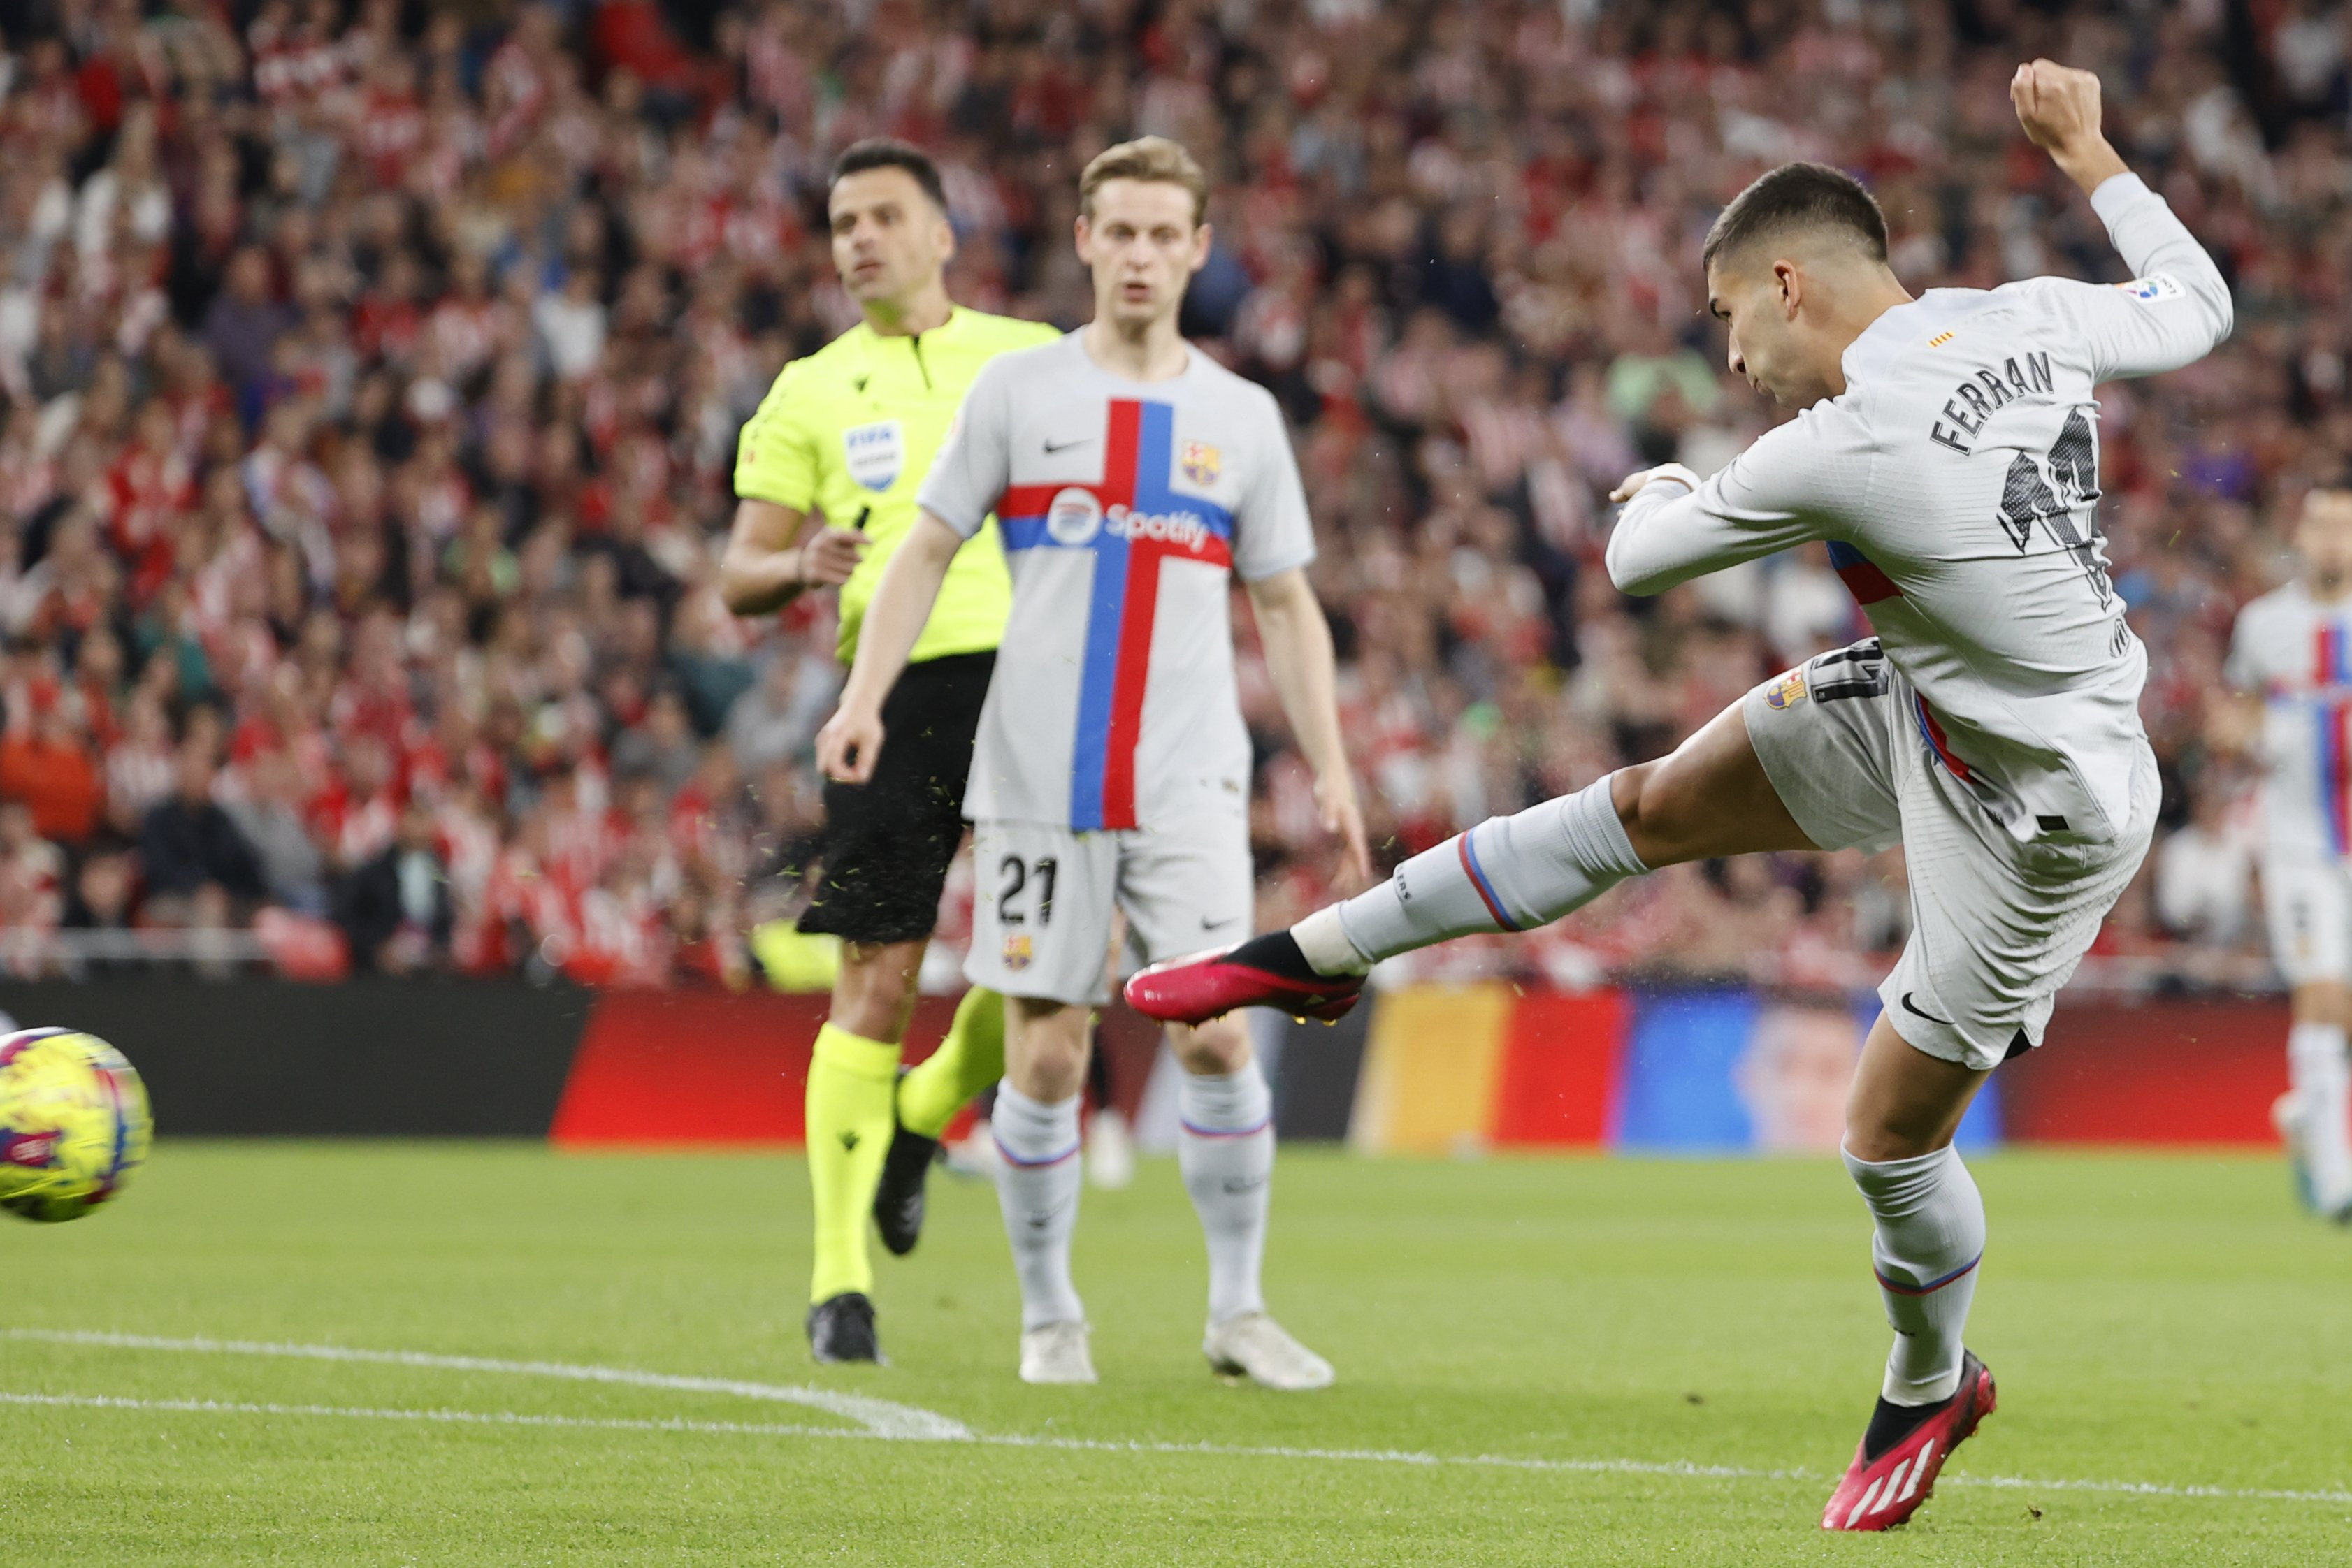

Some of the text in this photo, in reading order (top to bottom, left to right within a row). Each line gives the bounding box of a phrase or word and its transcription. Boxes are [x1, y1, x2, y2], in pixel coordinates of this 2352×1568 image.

[1930, 351, 2055, 456] FERRAN
[848, 427, 893, 448] FIFA
[1104, 503, 1209, 553] Spotify
[999, 854, 1058, 927] 21
